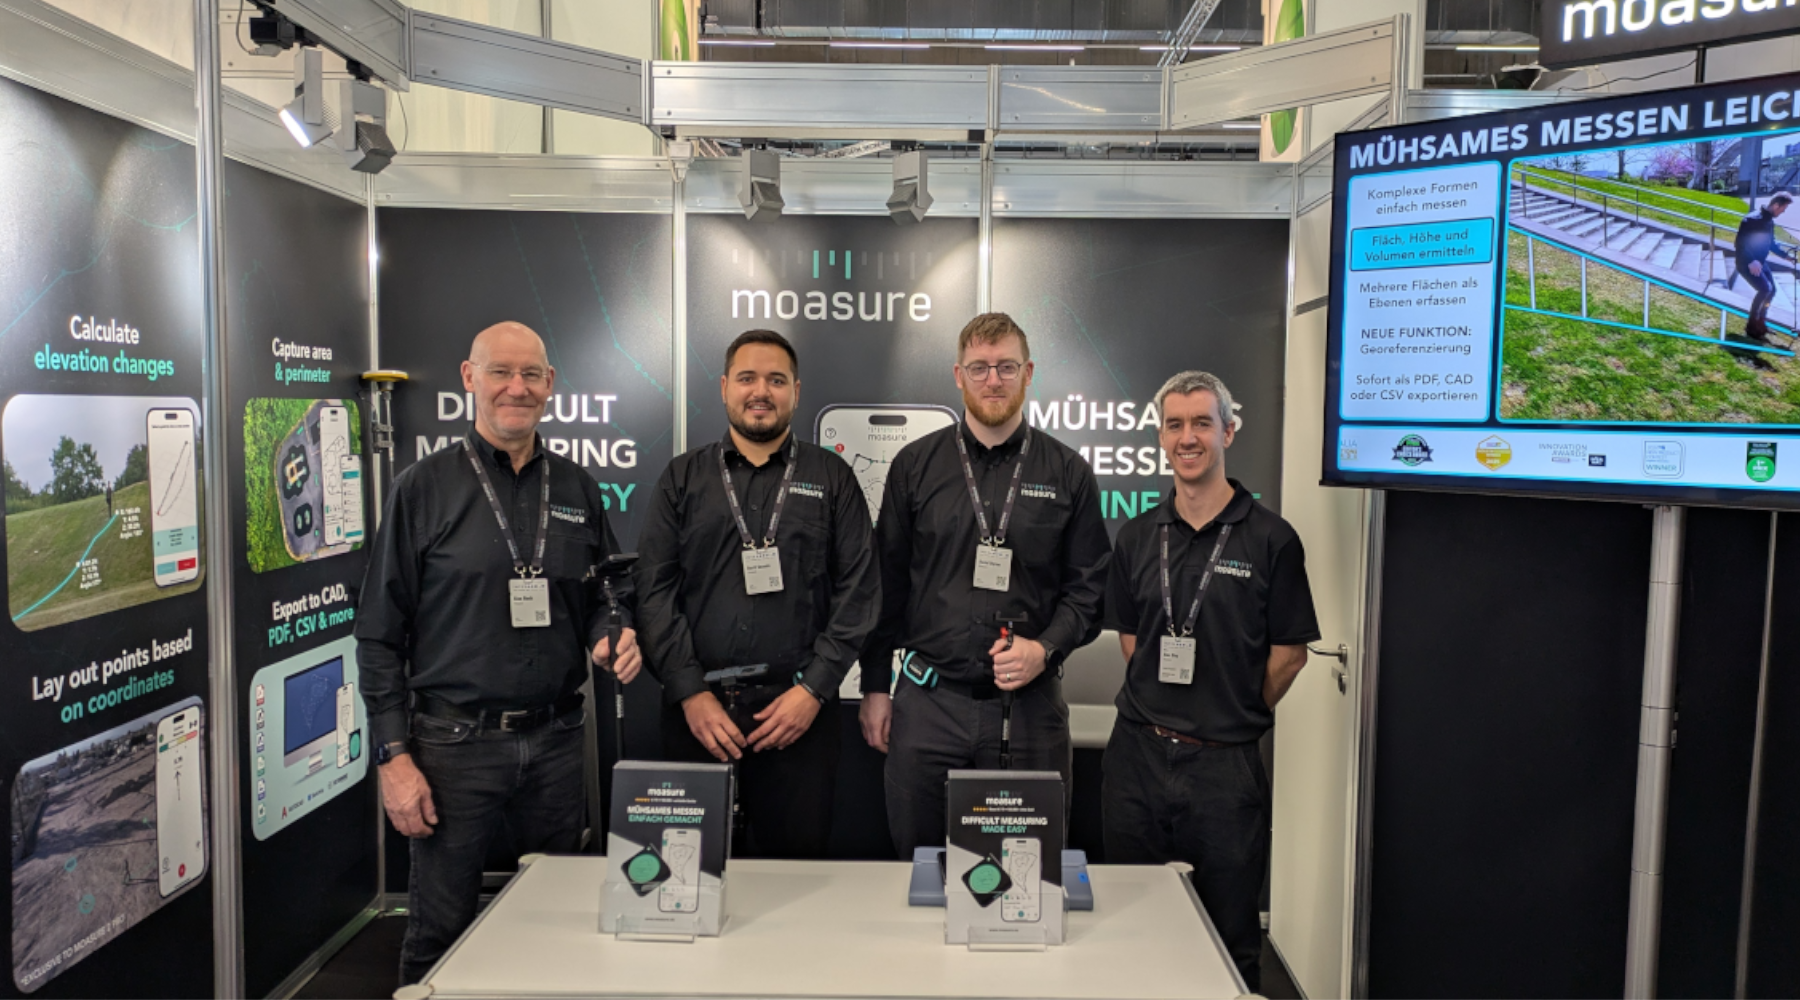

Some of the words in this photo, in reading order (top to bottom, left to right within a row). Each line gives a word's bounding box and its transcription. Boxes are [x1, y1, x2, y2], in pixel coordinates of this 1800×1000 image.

[1349, 124, 1528, 170] MÜHSAMES
[1541, 104, 1689, 147] MESSEN
[1367, 185, 1427, 200] Komplexe
[1430, 181, 1478, 194] Formen
[1375, 200, 1418, 215] einfach
[1421, 198, 1467, 211] messen
[1371, 232, 1406, 246] Fläch,
[1409, 231, 1441, 244] Höhe
[1445, 227, 1469, 241] und
[1364, 250, 1415, 263] Volumen
[1418, 244, 1475, 259] ermitteln
[1359, 281, 1409, 294] Mehrere
[1411, 278, 1458, 291] Flächen
[1461, 275, 1479, 289] als
[731, 289, 932, 322] moasure
[1368, 296, 1412, 309] Ebenen
[1415, 294, 1467, 307] erfassen
[69, 315, 140, 345] Calculate
[1361, 328, 1395, 340] NEUE
[1399, 326, 1473, 338] FUNKTION:
[271, 336, 311, 363] Capture
[312, 346, 333, 361] area
[1360, 343, 1472, 356] Georeferenzierung
[34, 343, 109, 373] elevation
[112, 349, 175, 381] changes
[275, 361, 284, 381] &
[285, 363, 332, 386] perimeter
[1356, 373, 1391, 386] Sofort
[1394, 374, 1410, 386] als
[1414, 374, 1441, 387] PDF,
[1444, 373, 1474, 386] CAD
[1350, 389, 1377, 401] oder
[1380, 389, 1404, 401] CSV
[1407, 389, 1479, 403] exportieren
[1029, 394, 1243, 431] MÜHSAS
[868, 434, 908, 442] moasure
[272, 595, 308, 622] Export
[308, 593, 320, 610] to
[321, 583, 349, 605] CAD,
[268, 623, 295, 648] PDF,
[296, 614, 317, 637] CSV
[318, 611, 328, 630] &
[329, 607, 355, 627] more
[31, 675, 65, 702] Lay
[69, 661, 99, 689] out
[102, 649, 150, 685] points
[151, 628, 193, 663] based
[60, 702, 84, 723] on
[88, 669, 175, 713] coordinates
[647, 788, 686, 797] moasure
[985, 797, 1023, 806] moasure
[627, 804, 672, 816] MÜHSAMES
[673, 807, 706, 816] MESSEN
[628, 814, 663, 824] EINFACH
[664, 815, 704, 824] GEMACHT
[961, 816, 1000, 826] DIFFICULT
[1001, 816, 1049, 826] MEASURING
[981, 825, 1006, 834] MADE
[1007, 825, 1028, 834] EASY
